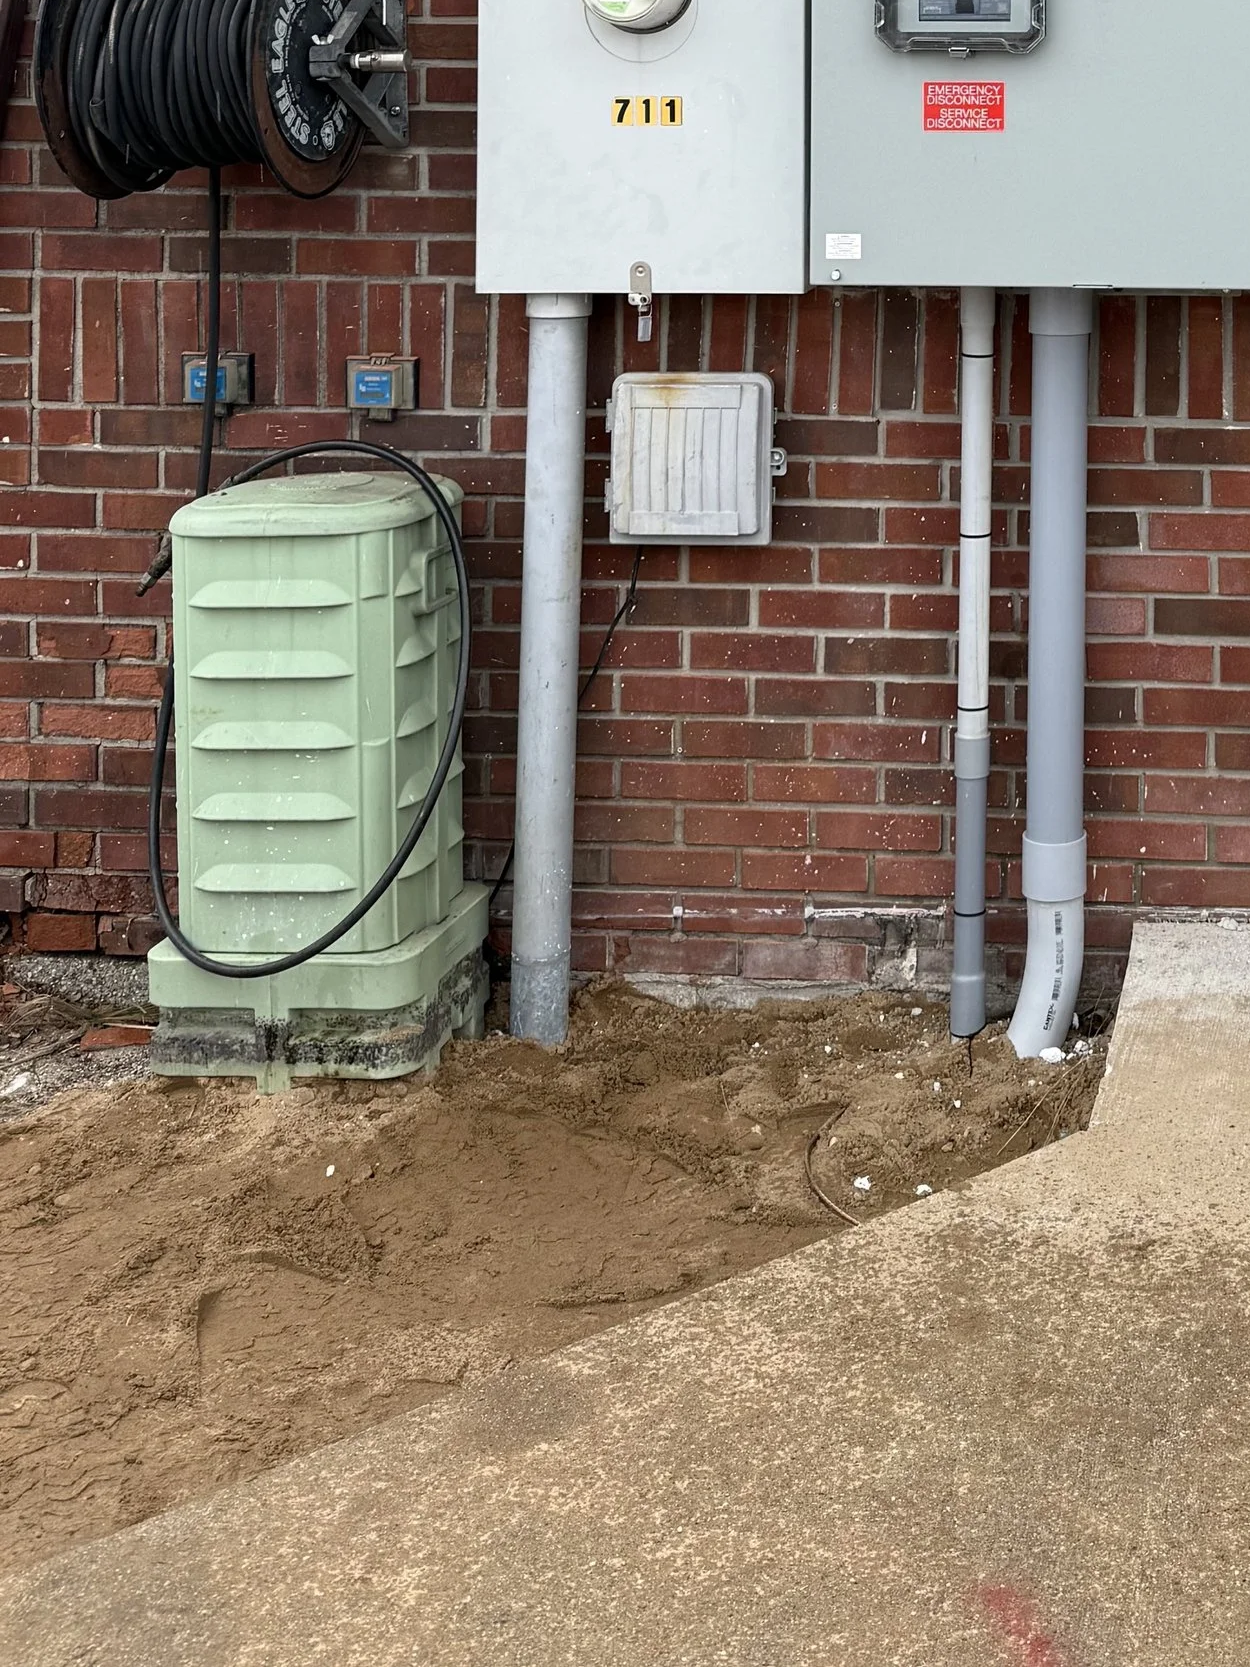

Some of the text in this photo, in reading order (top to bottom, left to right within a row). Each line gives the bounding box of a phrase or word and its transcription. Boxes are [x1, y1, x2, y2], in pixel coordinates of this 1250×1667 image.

[927, 85, 1001, 95] EMERGENCY
[926, 95, 1002, 105] DISCONNECT
[276, 79, 311, 145] STEEL
[615, 98, 676, 123] 711
[939, 108, 989, 118] SERVICE
[926, 119, 1002, 129] DISCONNECT
